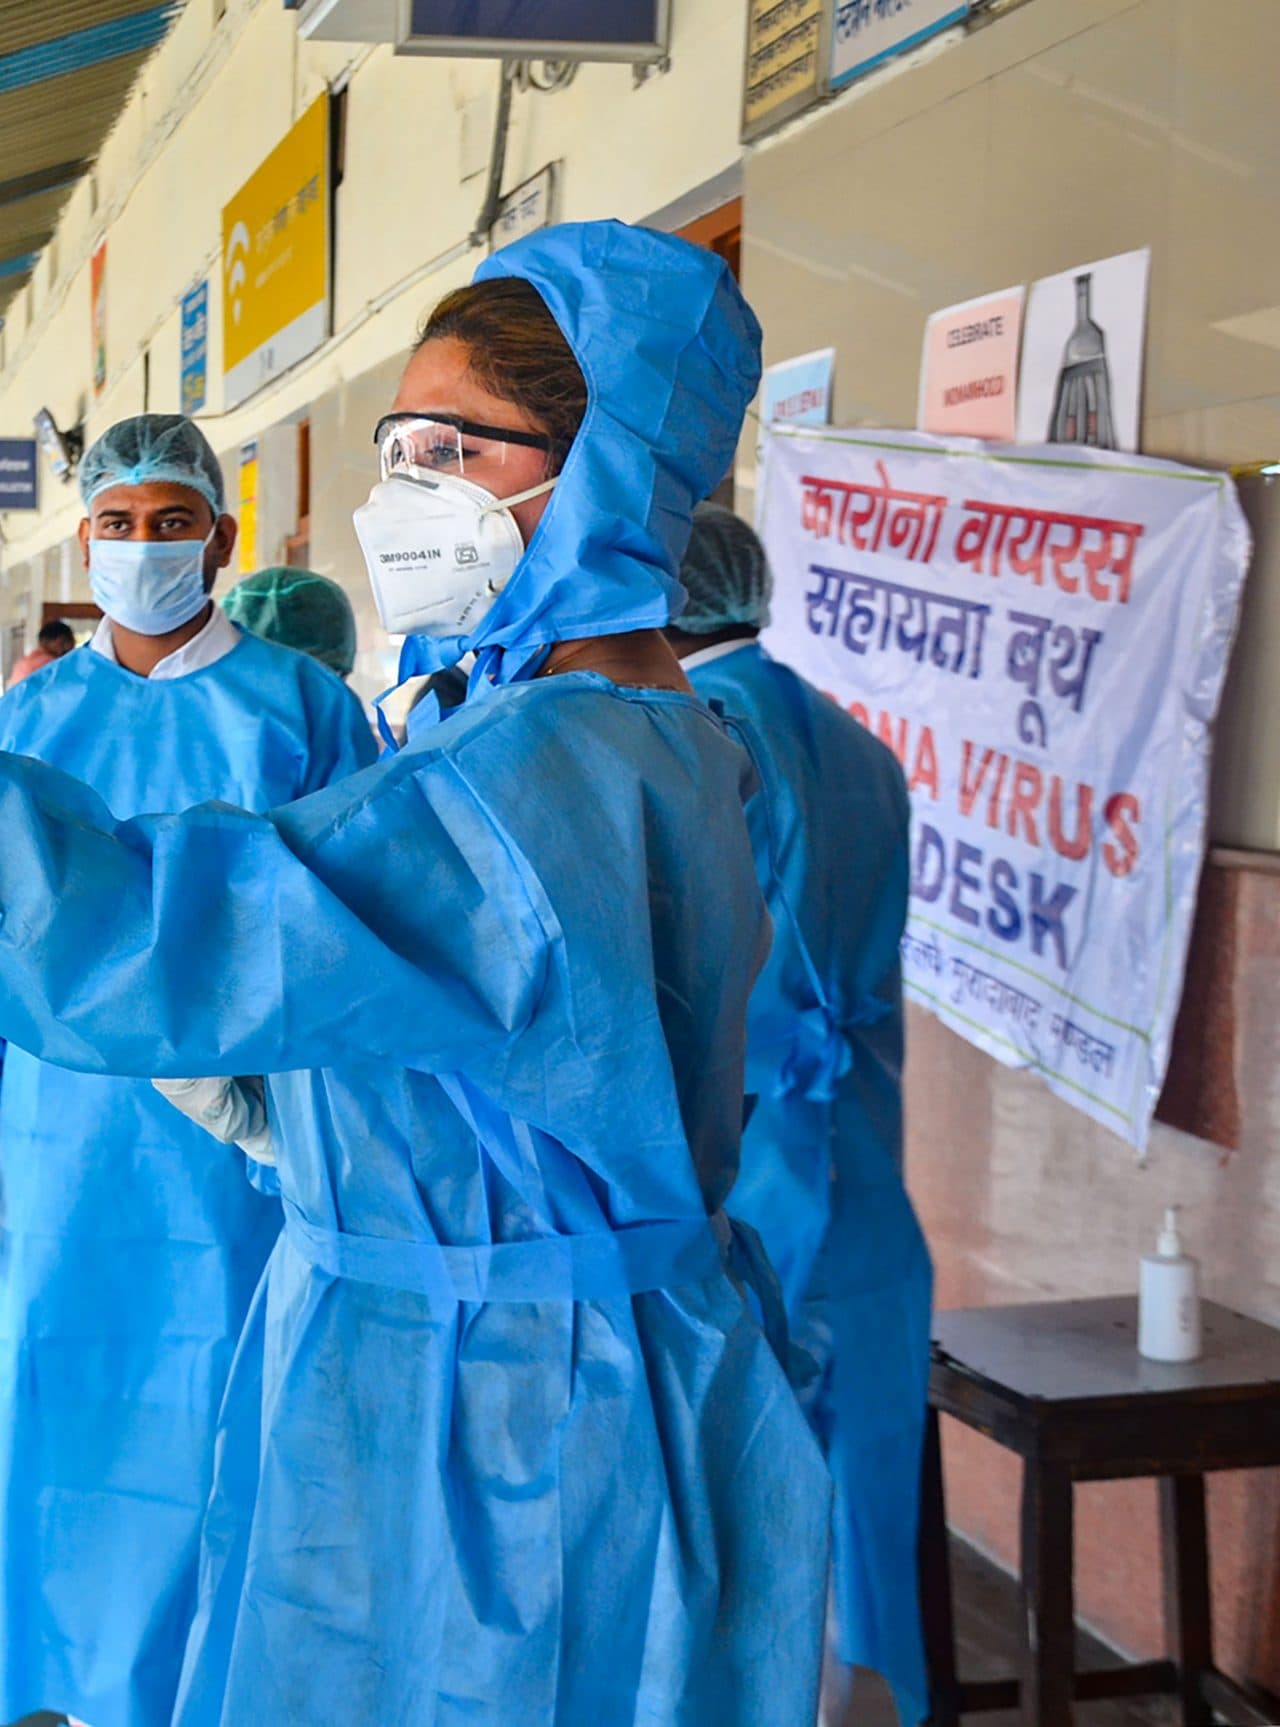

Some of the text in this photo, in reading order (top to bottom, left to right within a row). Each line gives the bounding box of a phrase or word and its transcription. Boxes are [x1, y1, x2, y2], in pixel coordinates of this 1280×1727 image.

[955, 500, 1145, 604] वायरस
[805, 564, 1104, 748] सहायता बूथ
[959, 739, 1140, 878] VIRUS
[910, 822, 1078, 971] DESK
